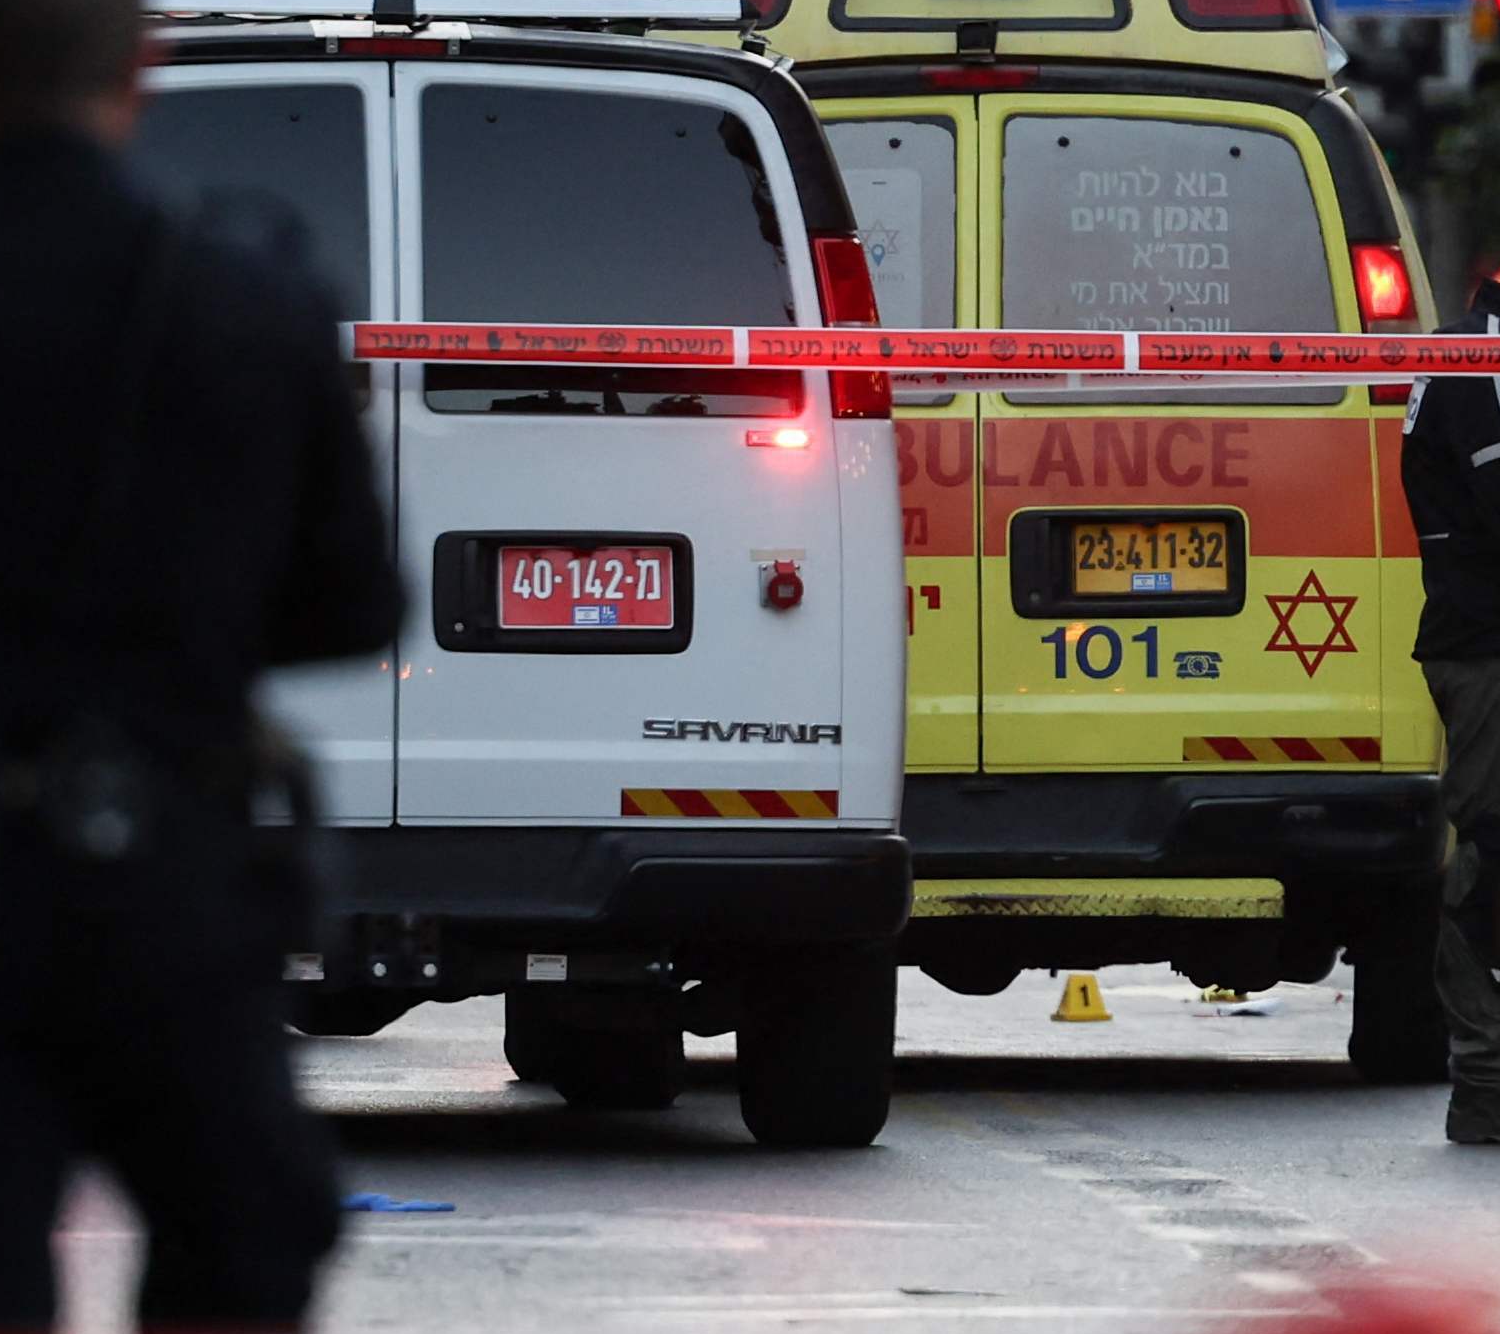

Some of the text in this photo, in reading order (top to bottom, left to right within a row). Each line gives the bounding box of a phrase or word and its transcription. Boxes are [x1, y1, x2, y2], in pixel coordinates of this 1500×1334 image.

[1077, 166, 1229, 199] בוא להיות
[1070, 206, 1229, 238] נאמן חיים
[1070, 275, 1229, 305] ותציל את מי
[368, 331, 725, 355] משטרת ישראל אין מעבר
[761, 338, 1116, 361] משטרת ישראל אין מעבר
[1151, 342, 1214, 363] מעבר
[1222, 343, 1252, 366] אין
[1297, 341, 1368, 364] ישראל
[1041, 626, 1159, 679] 101
[642, 717, 842, 744] SAVANA
[1079, 983, 1090, 1007] 1
